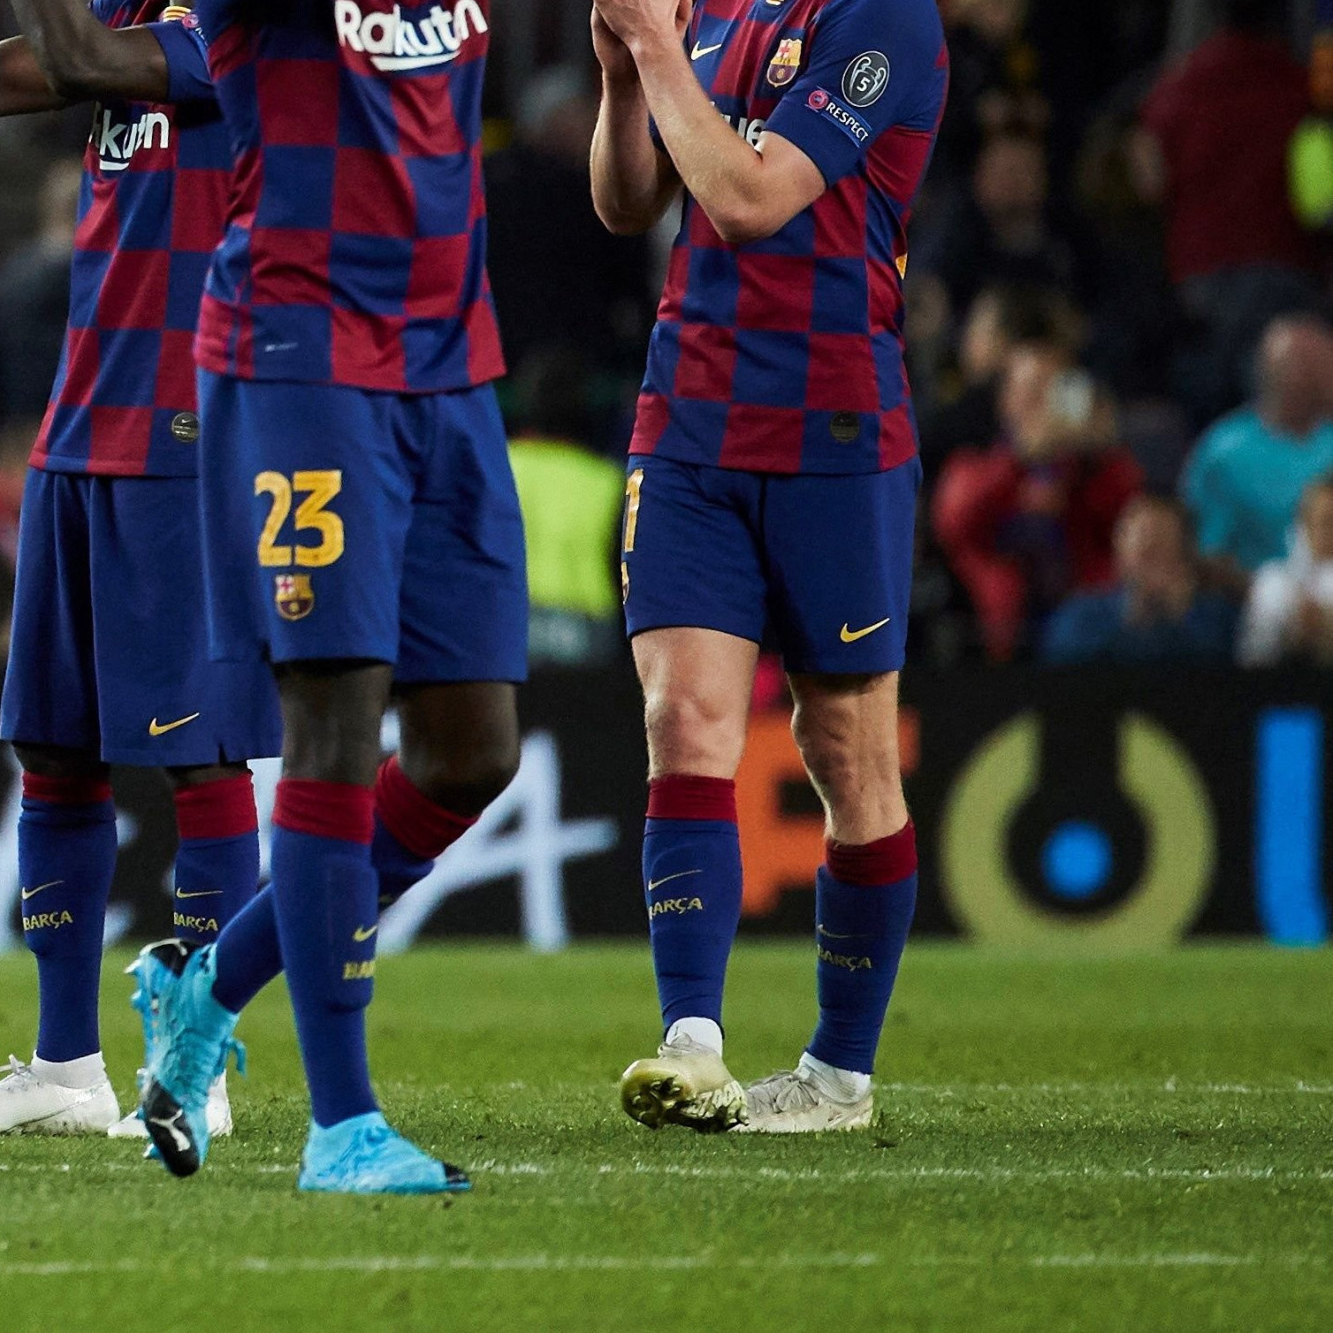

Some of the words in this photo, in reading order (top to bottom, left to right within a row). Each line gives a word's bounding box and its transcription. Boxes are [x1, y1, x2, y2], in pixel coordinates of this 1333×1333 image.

[856, 77, 871, 92] 5
[825, 102, 870, 143] RESPECT
[255, 469, 344, 567] 23
[23, 910, 74, 931] BARÇA
[173, 912, 219, 932] BARÇA
